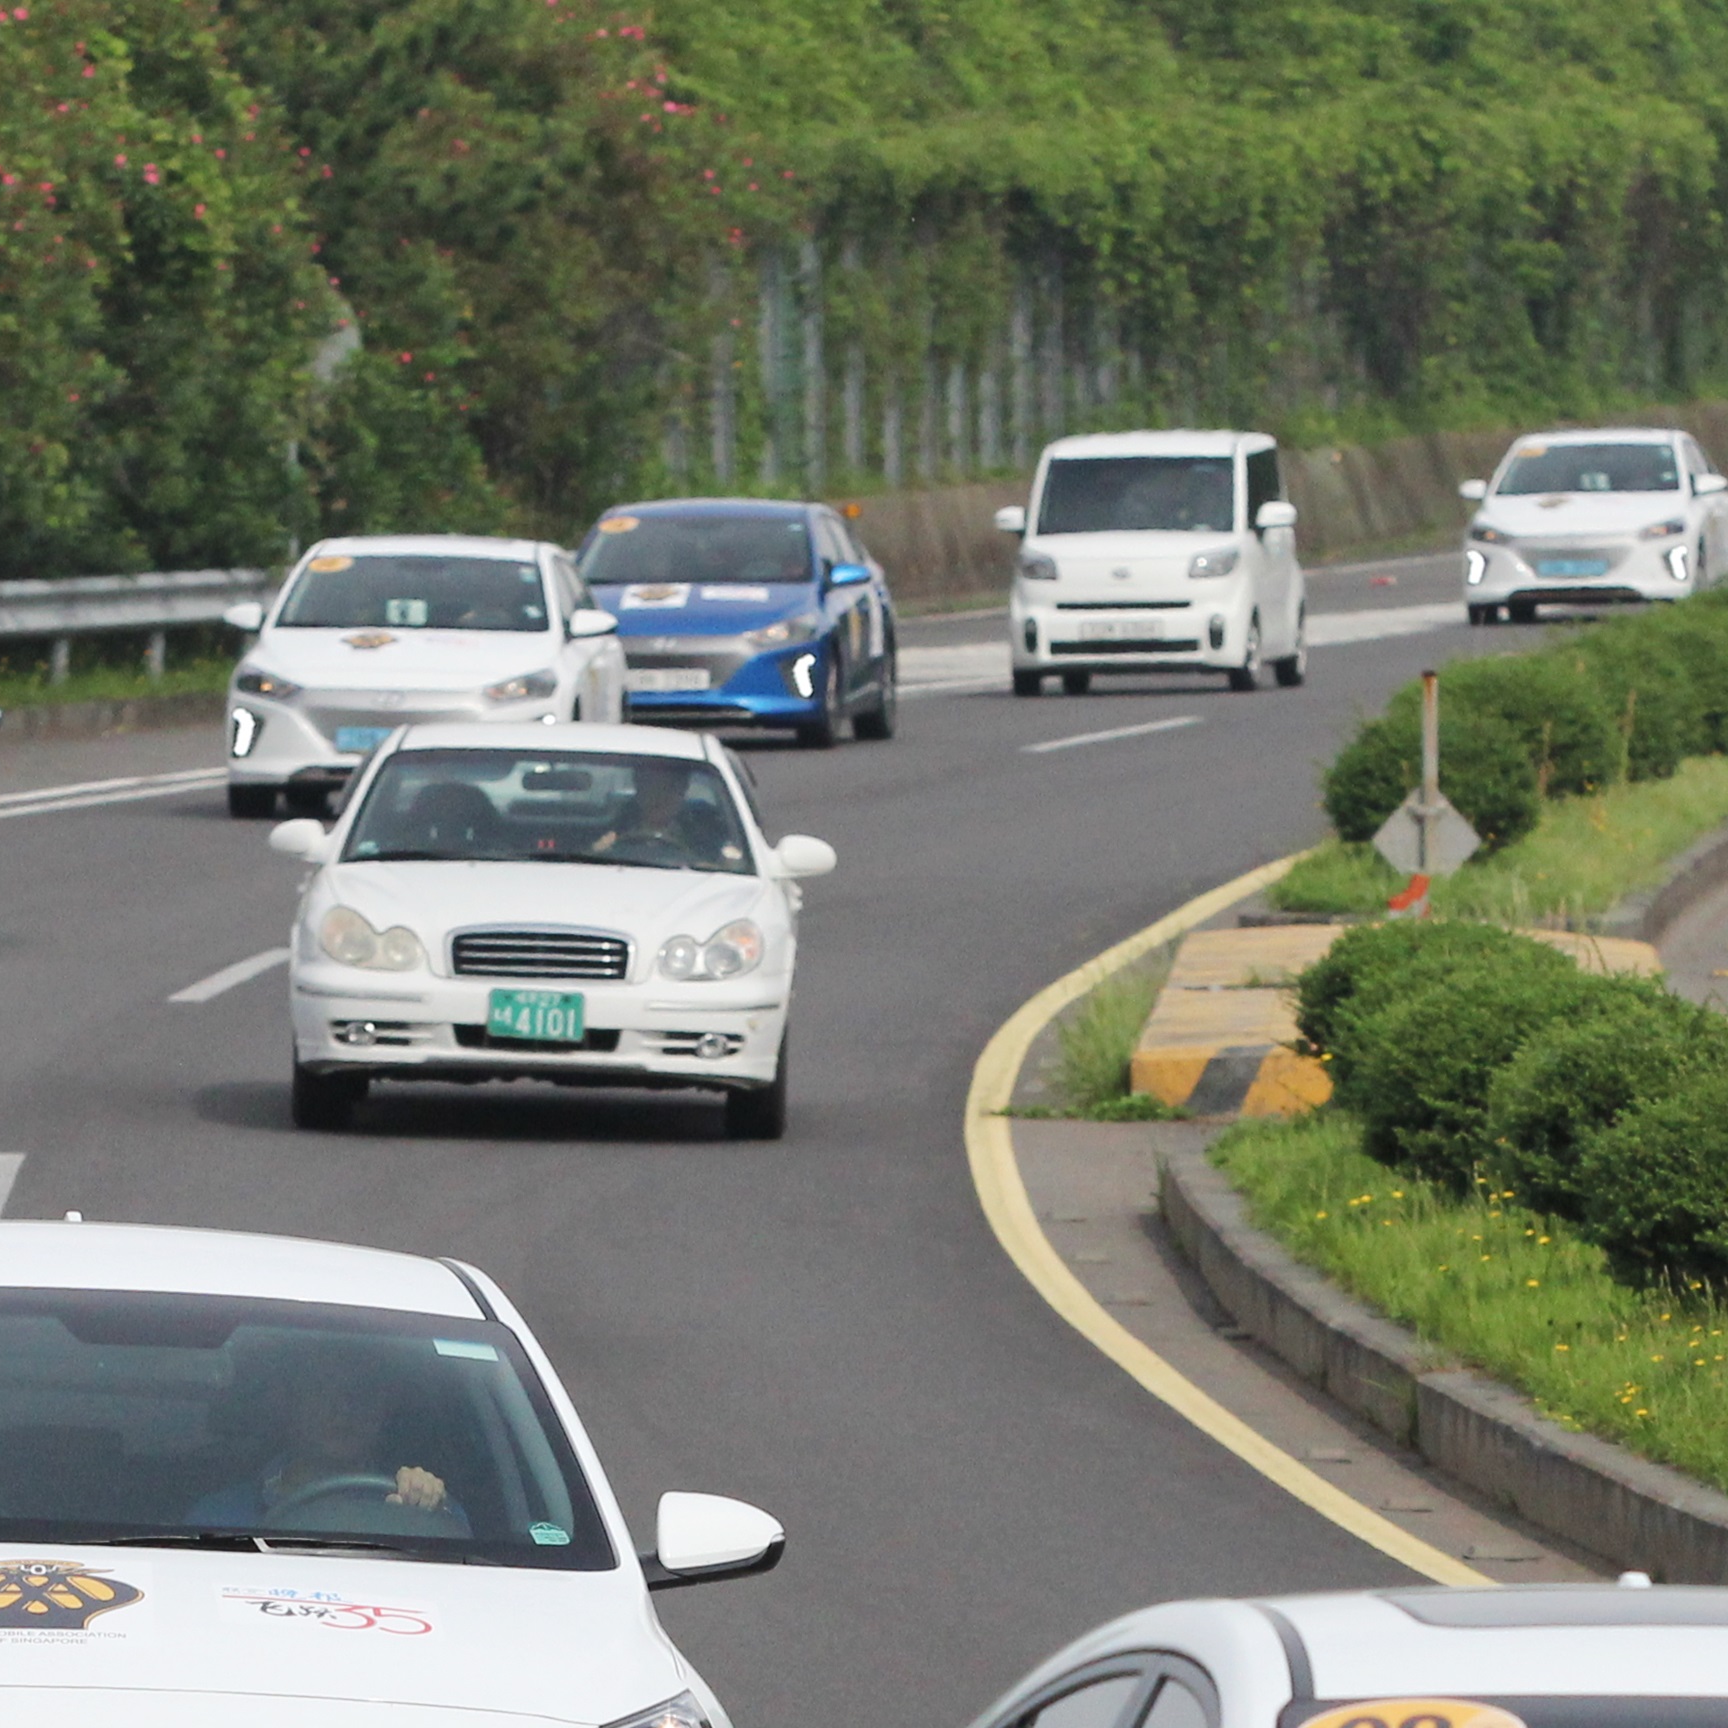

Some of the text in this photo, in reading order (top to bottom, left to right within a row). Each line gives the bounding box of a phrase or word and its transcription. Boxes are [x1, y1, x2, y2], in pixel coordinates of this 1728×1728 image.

[515, 1007, 575, 1038] 4101
[38, 1630, 127, 1639] ASSOCIATION
[10, 1637, 88, 1645] SINGAPORE
